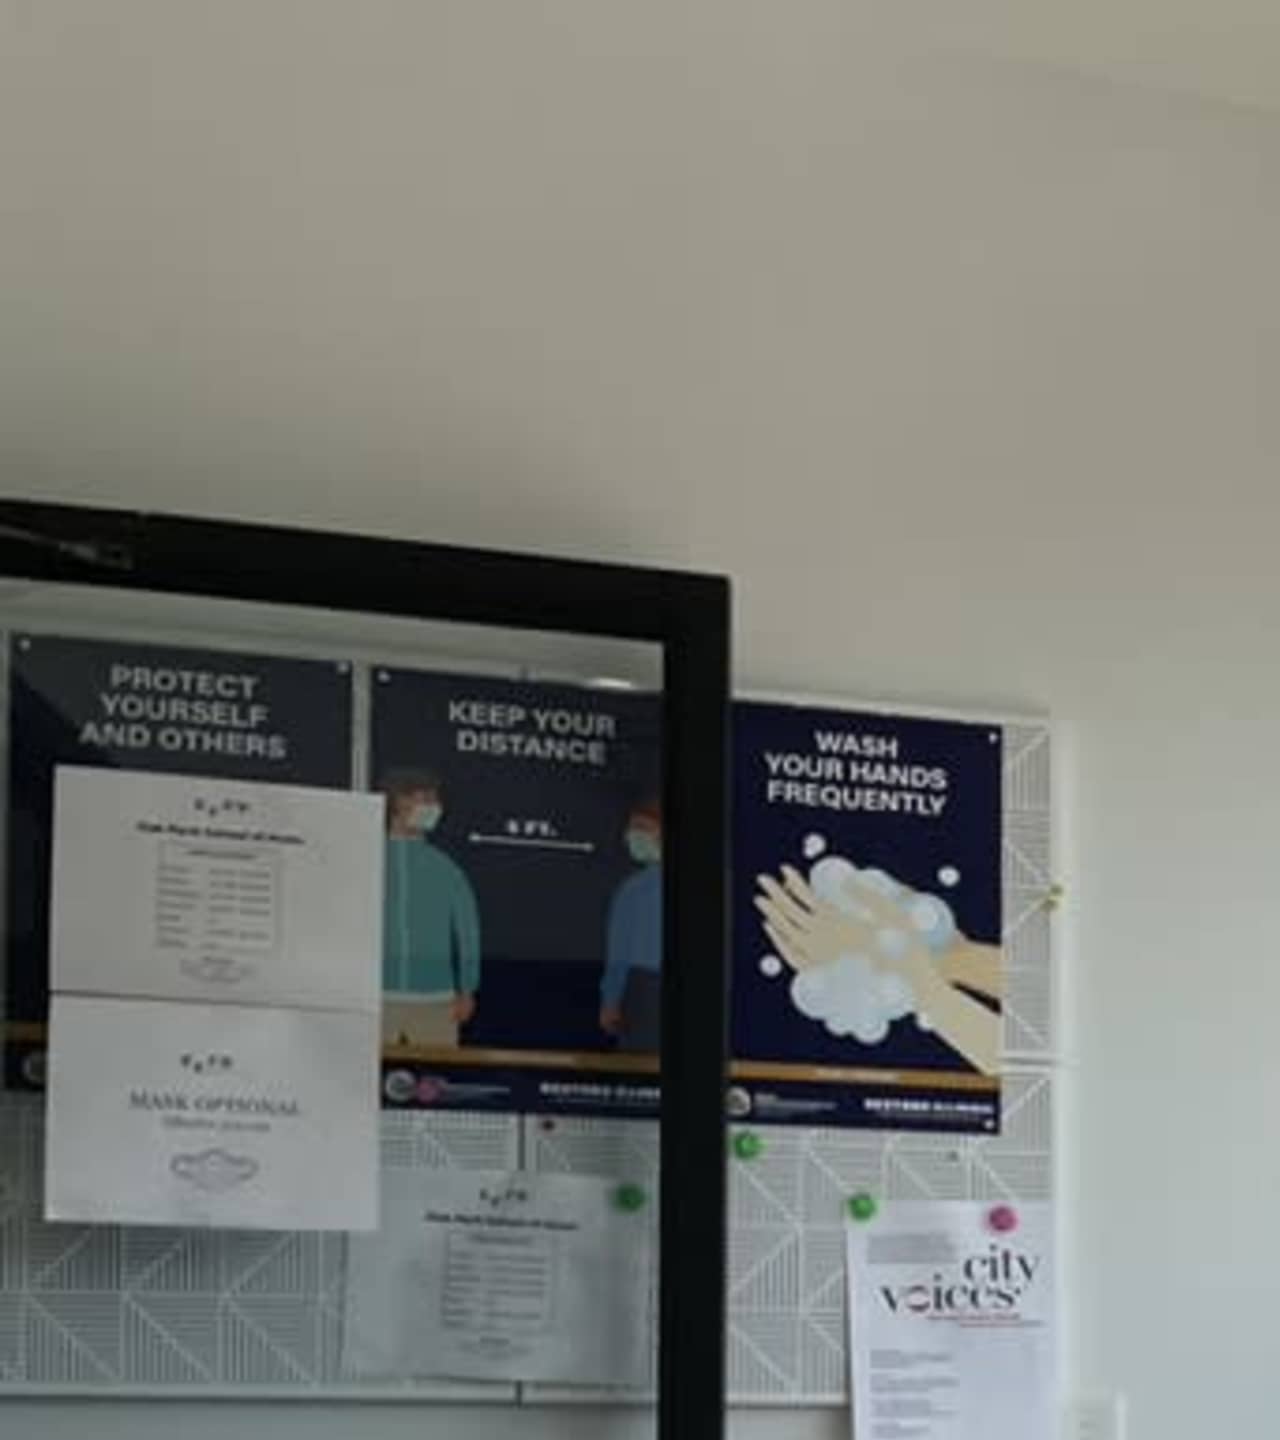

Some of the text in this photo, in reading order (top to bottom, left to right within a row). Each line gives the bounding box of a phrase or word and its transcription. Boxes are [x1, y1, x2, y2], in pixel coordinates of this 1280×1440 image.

[110, 664, 259, 699] PROTECT
[101, 693, 270, 729] YOURSELF
[450, 700, 617, 739] KEEP YOUR
[79, 722, 288, 759] AND OTHERS
[455, 728, 608, 767] DISTANCE
[814, 730, 899, 760] WASH
[764, 752, 949, 791] YOUR HANDS
[767, 779, 949, 817] FREQUENTLY
[963, 1243, 1040, 1285] city
